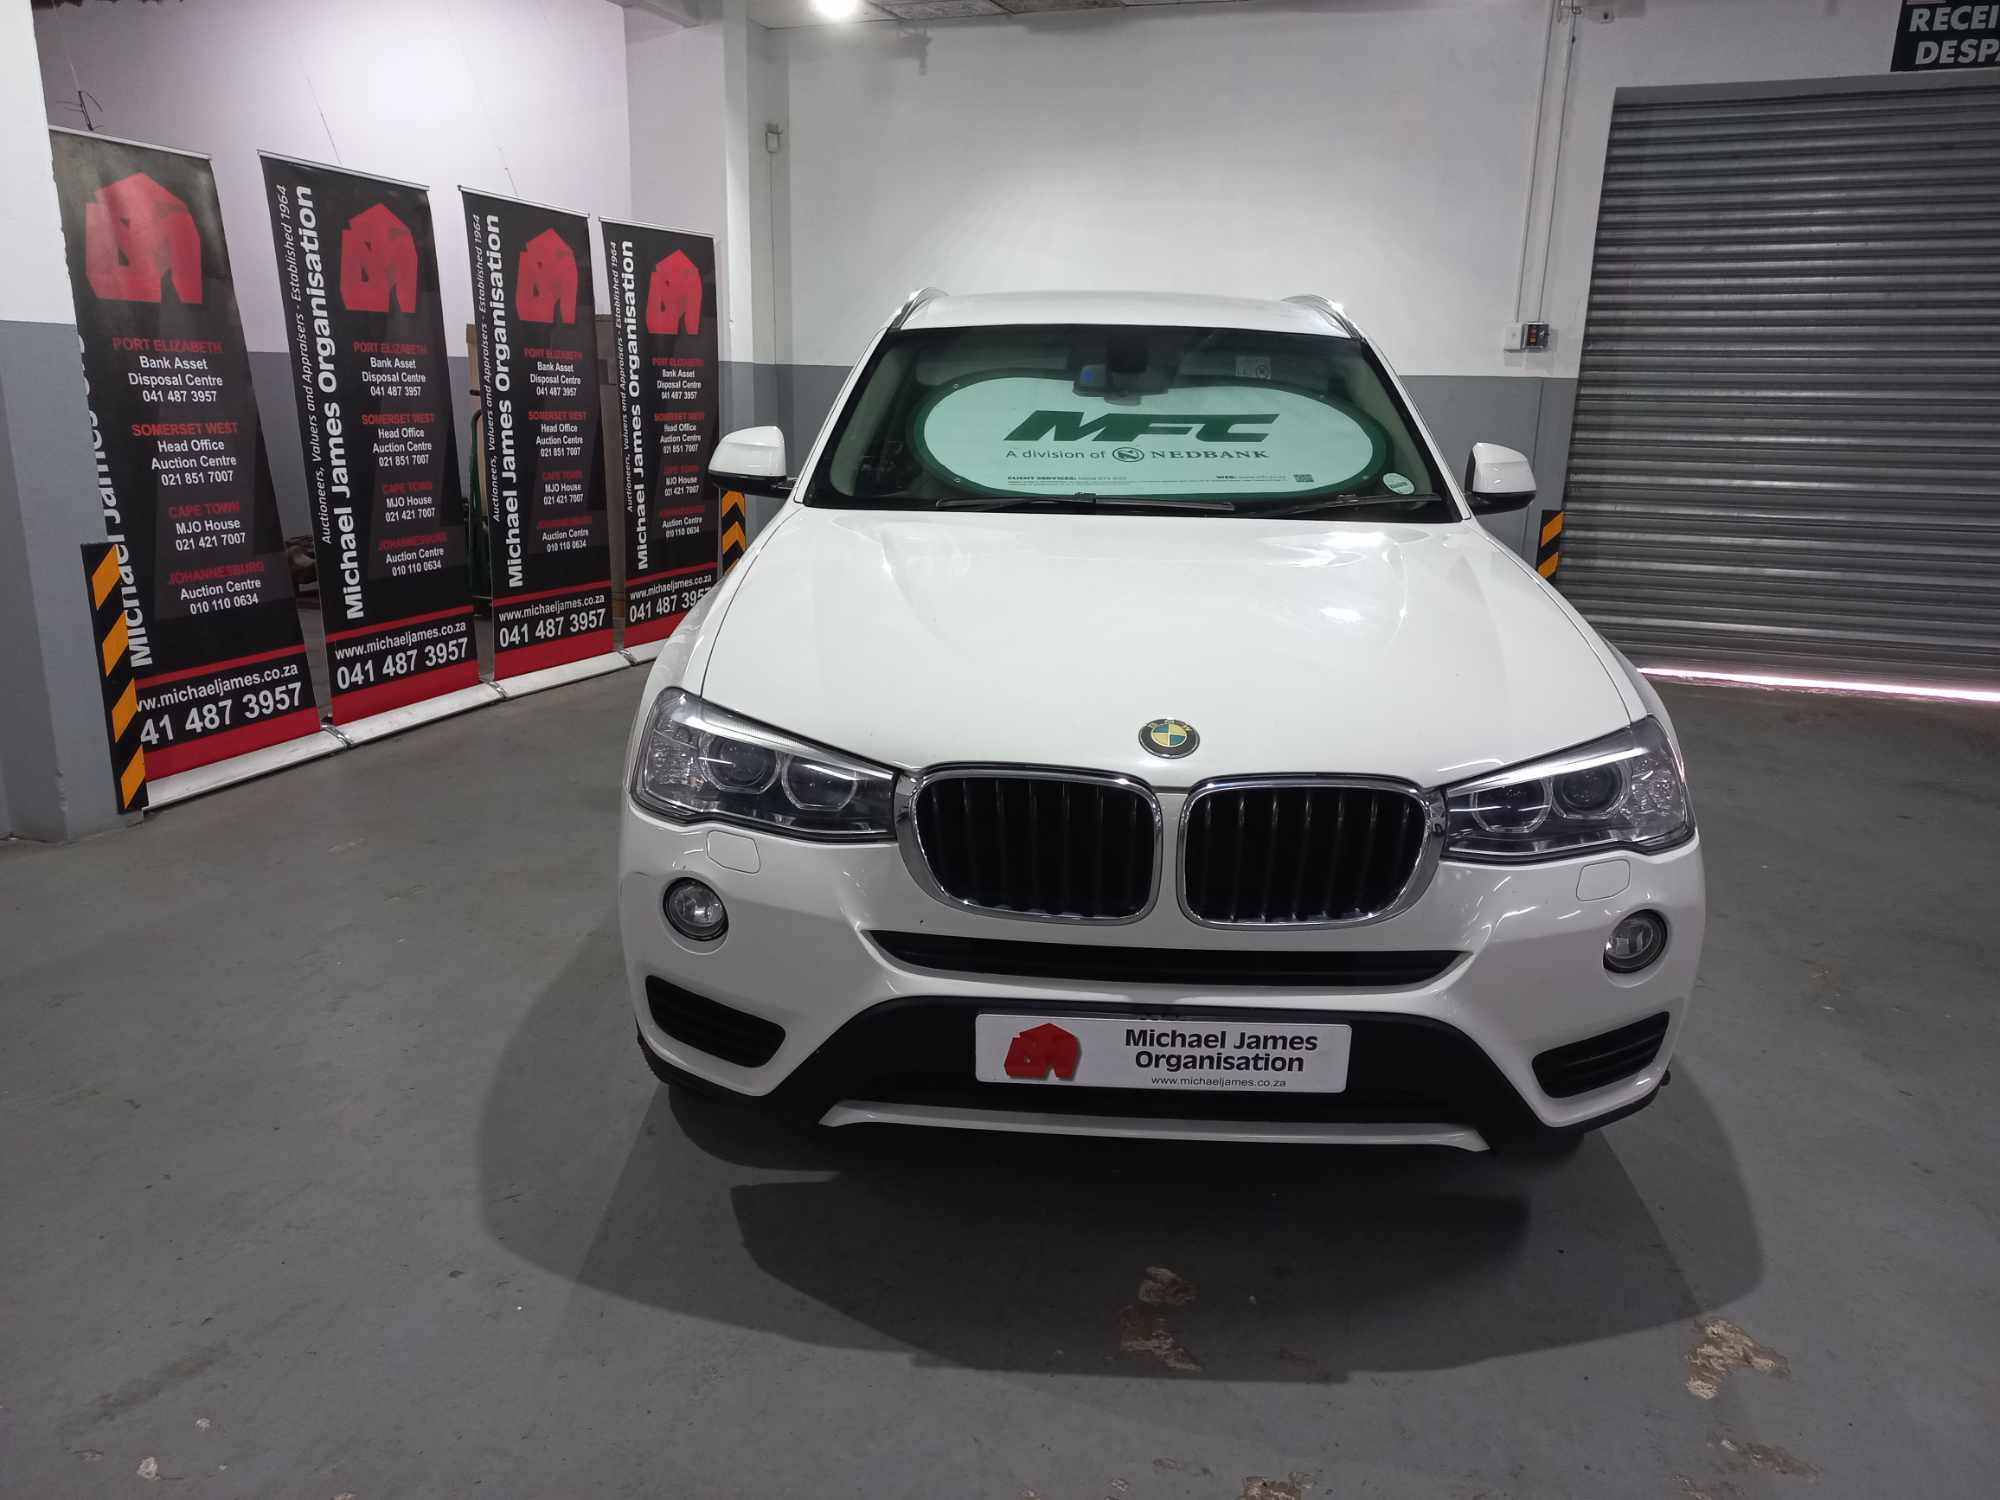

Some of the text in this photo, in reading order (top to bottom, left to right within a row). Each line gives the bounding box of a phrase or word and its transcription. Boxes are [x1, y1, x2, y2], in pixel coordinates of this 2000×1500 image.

[112, 336, 223, 353] PORT ELIZABETH
[140, 356, 208, 370] Bank Asset
[276, 184, 332, 544] Auctioneers, Valuers and Appraisers Established 1964
[370, 357, 416, 369] Bank Asset
[537, 361, 574, 372] Bank Asset
[128, 373, 223, 388] Disposal Centre
[362, 372, 426, 384] Disposal Centre
[530, 374, 559, 385] Disposal
[143, 390, 217, 402] 041 487 3957
[370, 386, 422, 397] 041 487 3957
[484, 385, 493, 408] and
[536, 387, 548, 396] 041
[296, 185, 364, 619] Michael James Organisation
[486, 215, 524, 588] Michael James Organisation
[621, 241, 648, 570] Michael James Organisation
[131, 422, 239, 437] SOMERSET WEST
[378, 427, 425, 439] Head Office
[541, 423, 578, 433] Head Office
[1003, 410, 1280, 443] MFC
[158, 439, 224, 453] Head Office
[372, 441, 432, 454] Auction Centre
[536, 435, 584, 446] Auction Centre
[379, 454, 429, 467] 021 851 7007
[1006, 449, 1270, 460] A division of NEDBANK
[151, 455, 237, 470] Auction Centre
[161, 470, 234, 486] 021 851 7007
[561, 483, 582, 492] House
[386, 496, 432, 509] MJO House
[168, 505, 202, 519] CAPE
[385, 508, 436, 522] 021 421 7007
[176, 519, 241, 535] MJO House
[175, 532, 246, 552] 021 421 7007
[542, 531, 567, 541] Auction
[386, 548, 444, 564] Auction Centre
[392, 560, 442, 577] 010 110 0634
[180, 578, 261, 601] Auction Centre
[189, 593, 259, 615] 010 110 0634
[499, 594, 605, 622] www.michaeljames.co.za
[629, 601, 652, 623] 041
[656, 595, 677, 616] 487
[500, 608, 606, 647] 041 487 3957
[335, 622, 467, 660] www.michaeljames.co.za
[337, 637, 468, 689] 041 487 3957
[185, 699, 233, 734] 487
[242, 681, 302, 720] 3957
[1125, 1028, 1318, 1052] Michael James
[1135, 1050, 1305, 1074] Organisation
[1151, 1075, 1287, 1088] www.michaeljames.co.za
